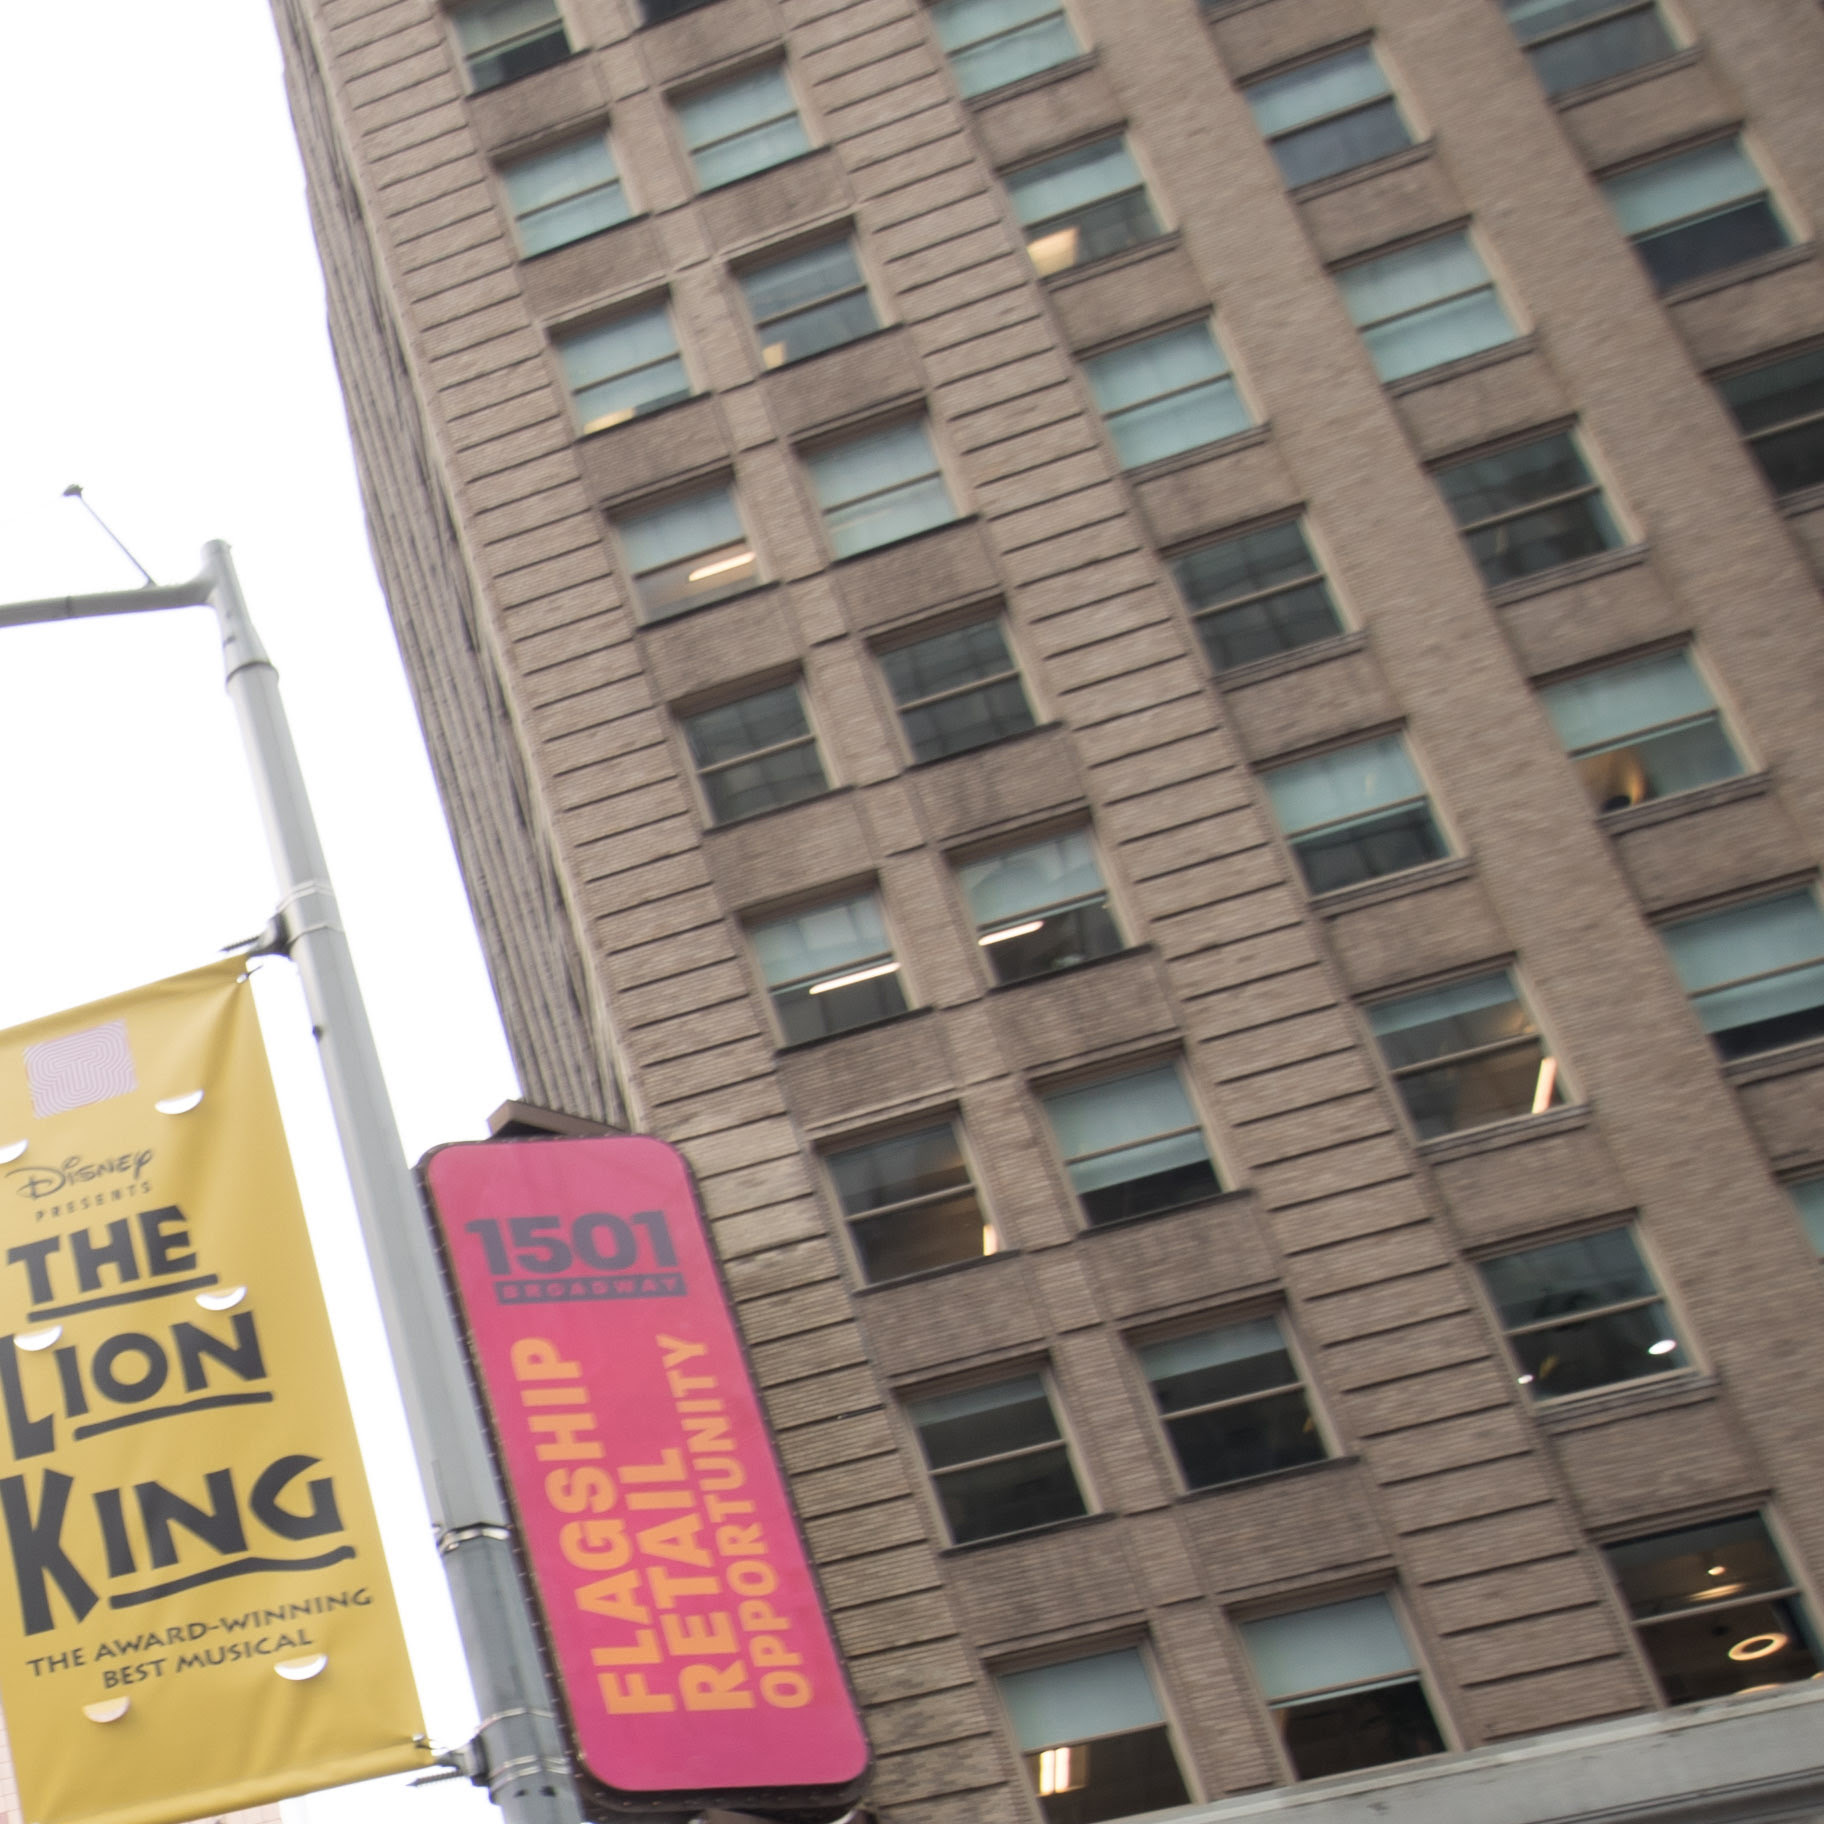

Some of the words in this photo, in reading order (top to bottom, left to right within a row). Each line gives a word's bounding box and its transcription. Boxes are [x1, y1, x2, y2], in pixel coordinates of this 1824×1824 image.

[35, 1182, 152, 1222] PRESENTS
[465, 1210, 680, 1275] 1501
[7, 1204, 198, 1306] THE
[502, 1276, 683, 1299] BROADWAY
[509, 1336, 676, 1715] FLAGSHIP
[655, 1333, 814, 1710] OPPORTUNITY
[616, 1446, 755, 1712] RETAIL
[26, 1646, 88, 1678] THE
[95, 1587, 375, 1662] AWARD-WINNING
[103, 1658, 164, 1691] BEST
[176, 1629, 315, 1673] MUSICAL
